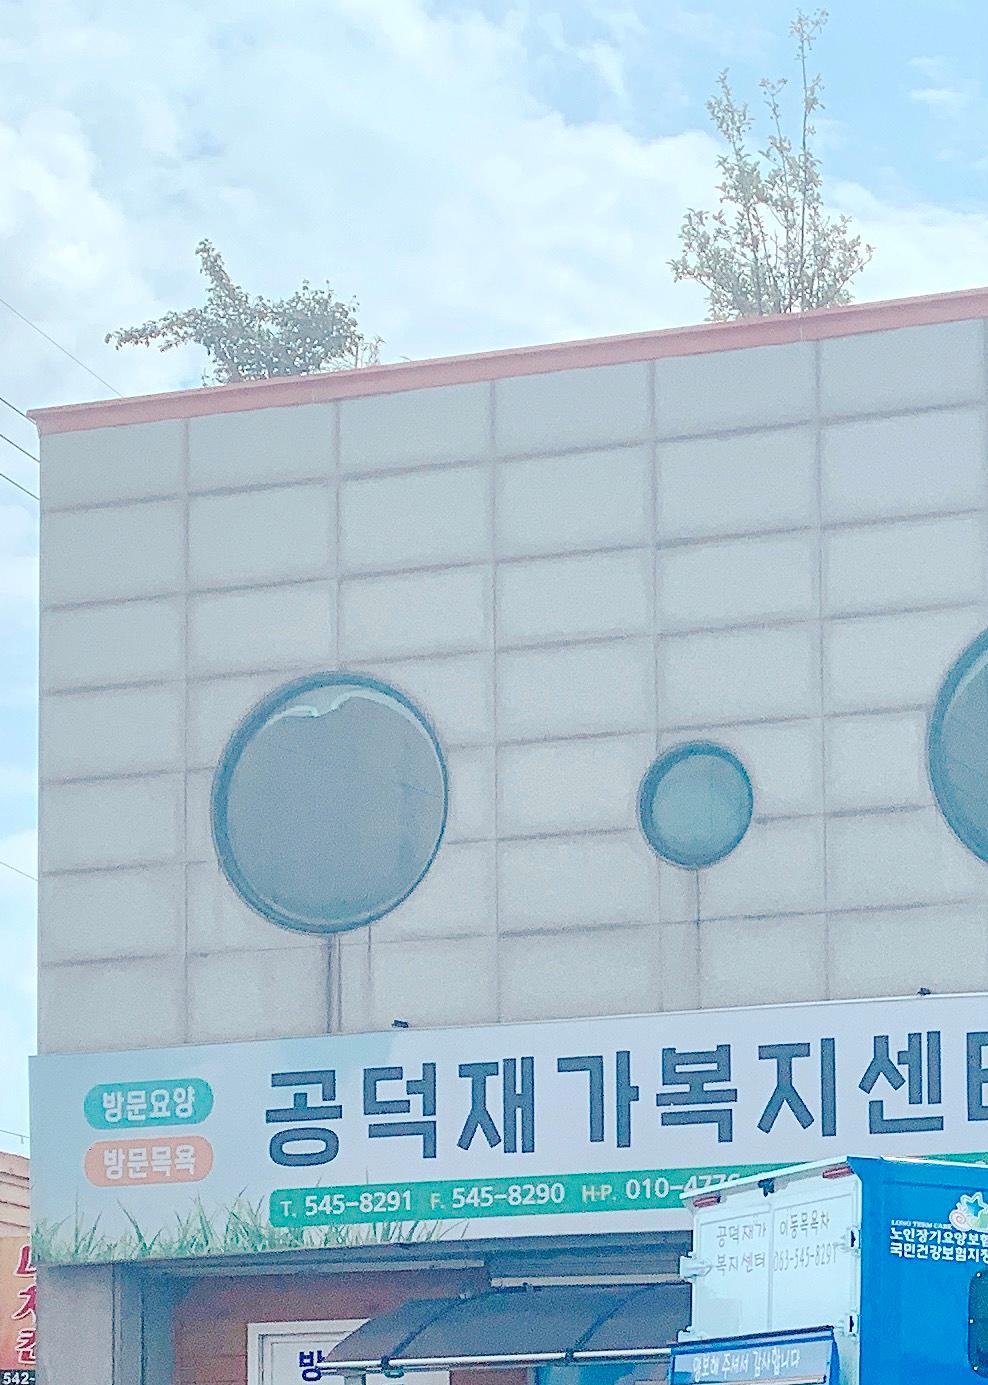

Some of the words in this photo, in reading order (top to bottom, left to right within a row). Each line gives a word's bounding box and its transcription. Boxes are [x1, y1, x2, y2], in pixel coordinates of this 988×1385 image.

[102, 1085, 196, 1124] 방문요양
[103, 1143, 196, 1180] 방문목욕
[305, 1190, 412, 1217] 545-8291
[452, 1183, 566, 1210] 545-8290
[716, 1222, 767, 1248] 공덕재가
[779, 1210, 831, 1239] 이동목욕차
[715, 1252, 766, 1277] 복지센터
[753, 1346, 801, 1378] 감사합니다
